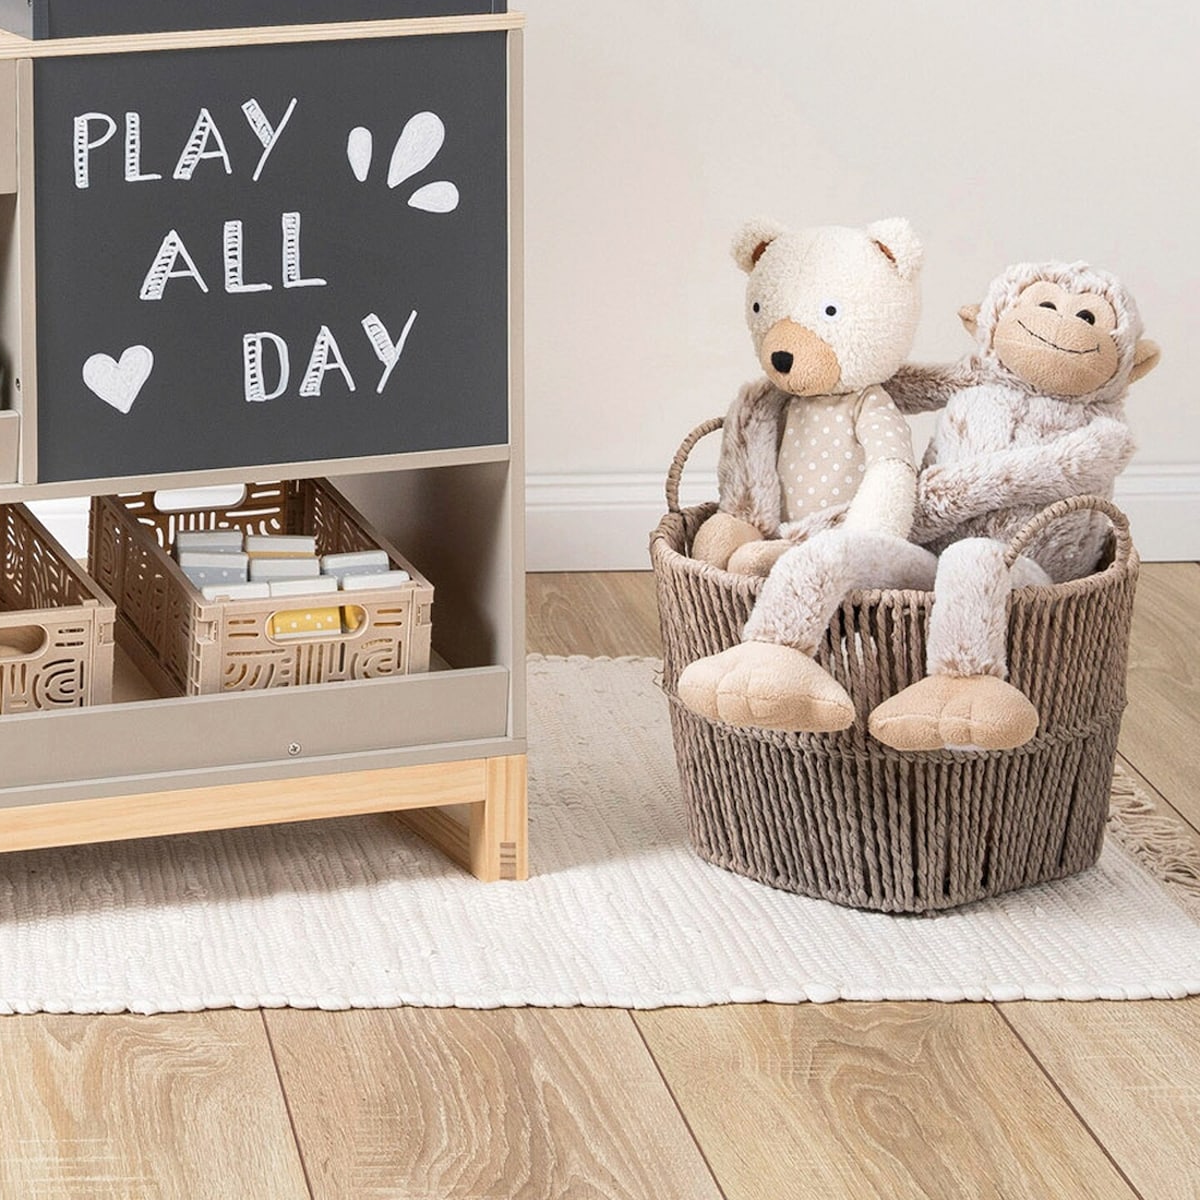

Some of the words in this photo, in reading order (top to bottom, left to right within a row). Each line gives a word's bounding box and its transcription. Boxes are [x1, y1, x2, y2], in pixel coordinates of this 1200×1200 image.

[73, 97, 298, 189] PLAY
[139, 211, 327, 300] ALL
[242, 309, 418, 402] DAY
